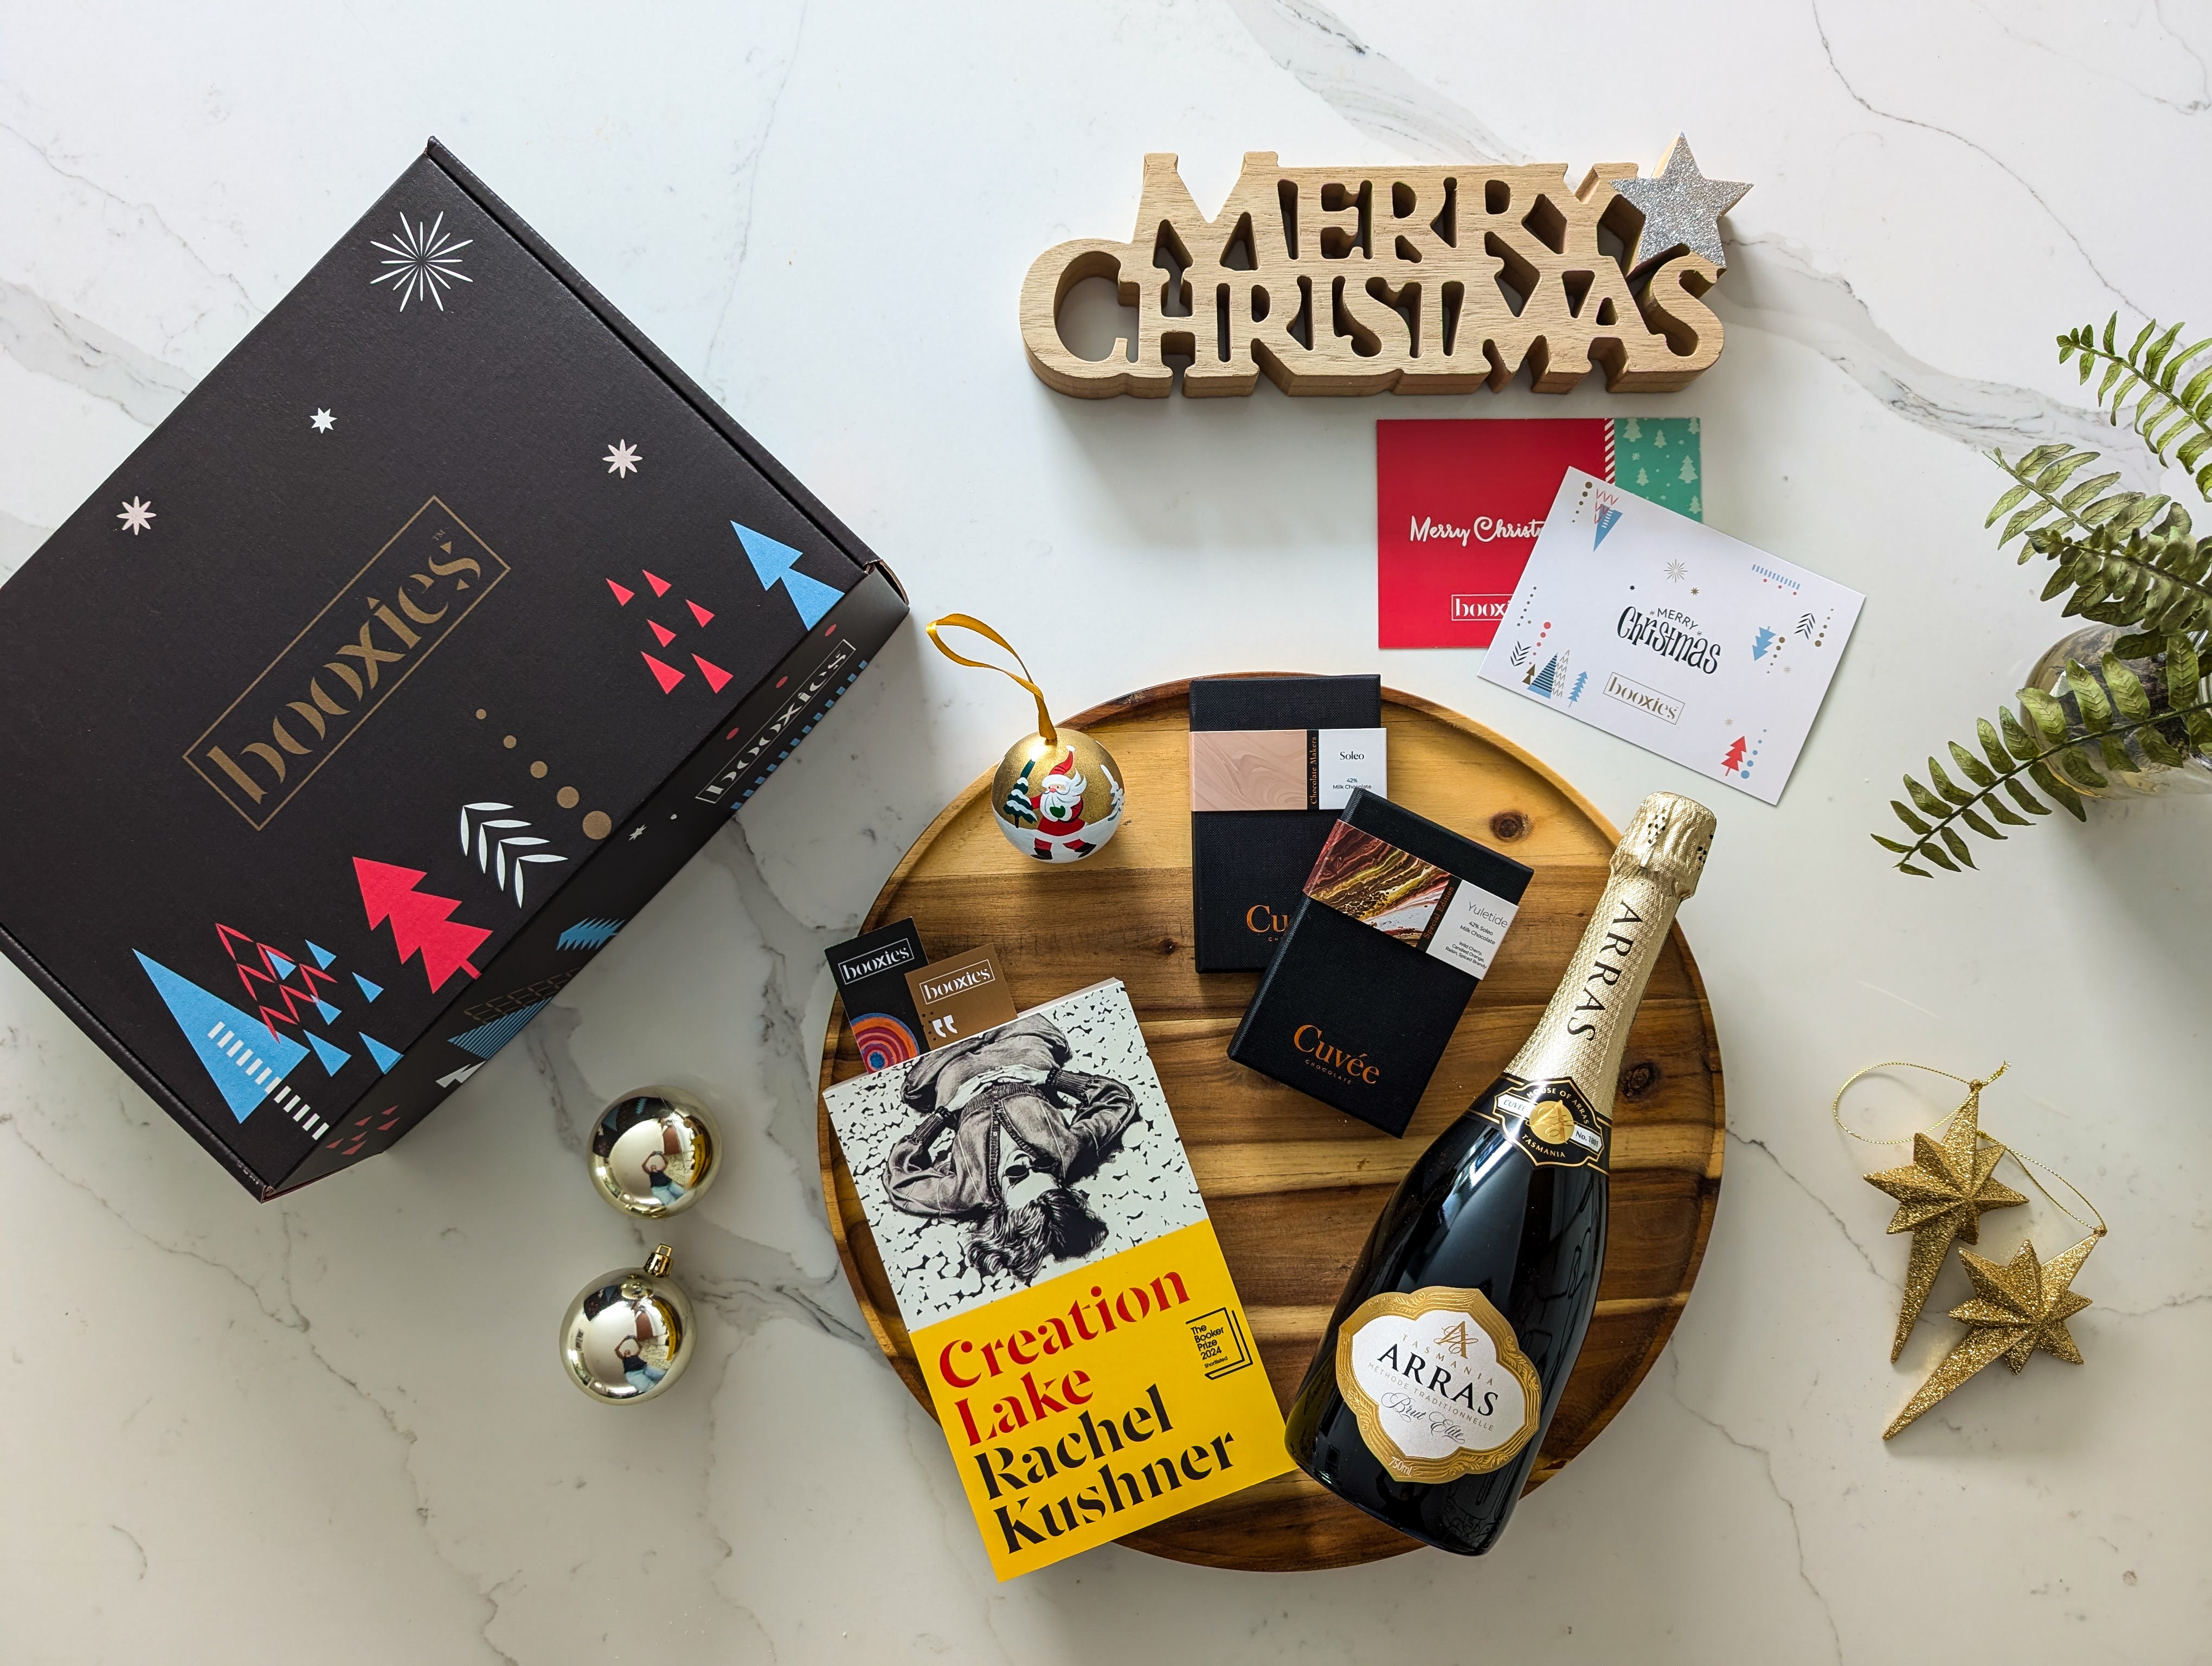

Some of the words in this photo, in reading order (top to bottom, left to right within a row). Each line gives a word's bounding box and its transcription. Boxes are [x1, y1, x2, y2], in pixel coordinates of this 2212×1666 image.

[1135, 151, 1648, 266] MERRY
[1019, 238, 1725, 388] CHRISTMAS
[1410, 515, 1471, 547] Merry
[1657, 607, 1699, 630] MERRY
[1617, 606, 1721, 674] Christmas
[206, 541, 481, 804] booxies
[1608, 676, 1677, 720] booxies
[706, 653, 846, 795] booxies
[1340, 751, 1365, 760] Soleo
[1423, 913, 1440, 939] Special
[1437, 887, 1454, 912] Edition
[1468, 901, 1508, 928] Yuletide
[1469, 921, 1480, 929] 42%
[1480, 926, 1494, 935] Soleo
[1452, 944, 1469, 954] Candied
[1459, 925, 1470, 933] Milk
[1471, 930, 1495, 945] Chocolate
[842, 947, 910, 980] booxies
[1458, 952, 1472, 962] Spiced
[1472, 959, 1487, 969] Brandy
[1566, 899, 1643, 1042] ARRAS
[923, 968, 991, 1000] booxies
[1294, 1024, 1380, 1084] Cuvée
[1305, 1059, 1352, 1085] CHOCOLATE
[1503, 1099, 1526, 1112] CUVÉE
[1526, 1087, 1557, 1098] HOUSE
[1559, 1090, 1572, 1099] OF
[1572, 1099, 1590, 1124] ARRAS
[1522, 1134, 1566, 1158] TASMANIA
[1576, 1130, 1587, 1141] No.
[939, 1271, 1191, 1388] Creation
[1190, 1324, 1207, 1335] The
[1194, 1327, 1224, 1343] Booker
[1197, 1339, 1218, 1352] Prize
[1200, 1345, 1222, 1360] 2024
[1204, 1355, 1229, 1368] Shortlisted
[1403, 1334, 1494, 1386] TASMANIA
[1377, 1343, 1499, 1417] ARRAS
[955, 1369, 1094, 1446] Lake
[1367, 1362, 1410, 1389] MÉTHODE
[1413, 1387, 1494, 1432] TRADITIONNELLE
[1381, 1392, 1427, 1423] Brut
[1429, 1411, 1466, 1444] Elite
[973, 1383, 1174, 1501] Rachel
[1389, 1456, 1413, 1477] 750mL
[993, 1431, 1234, 1554] Kushner
